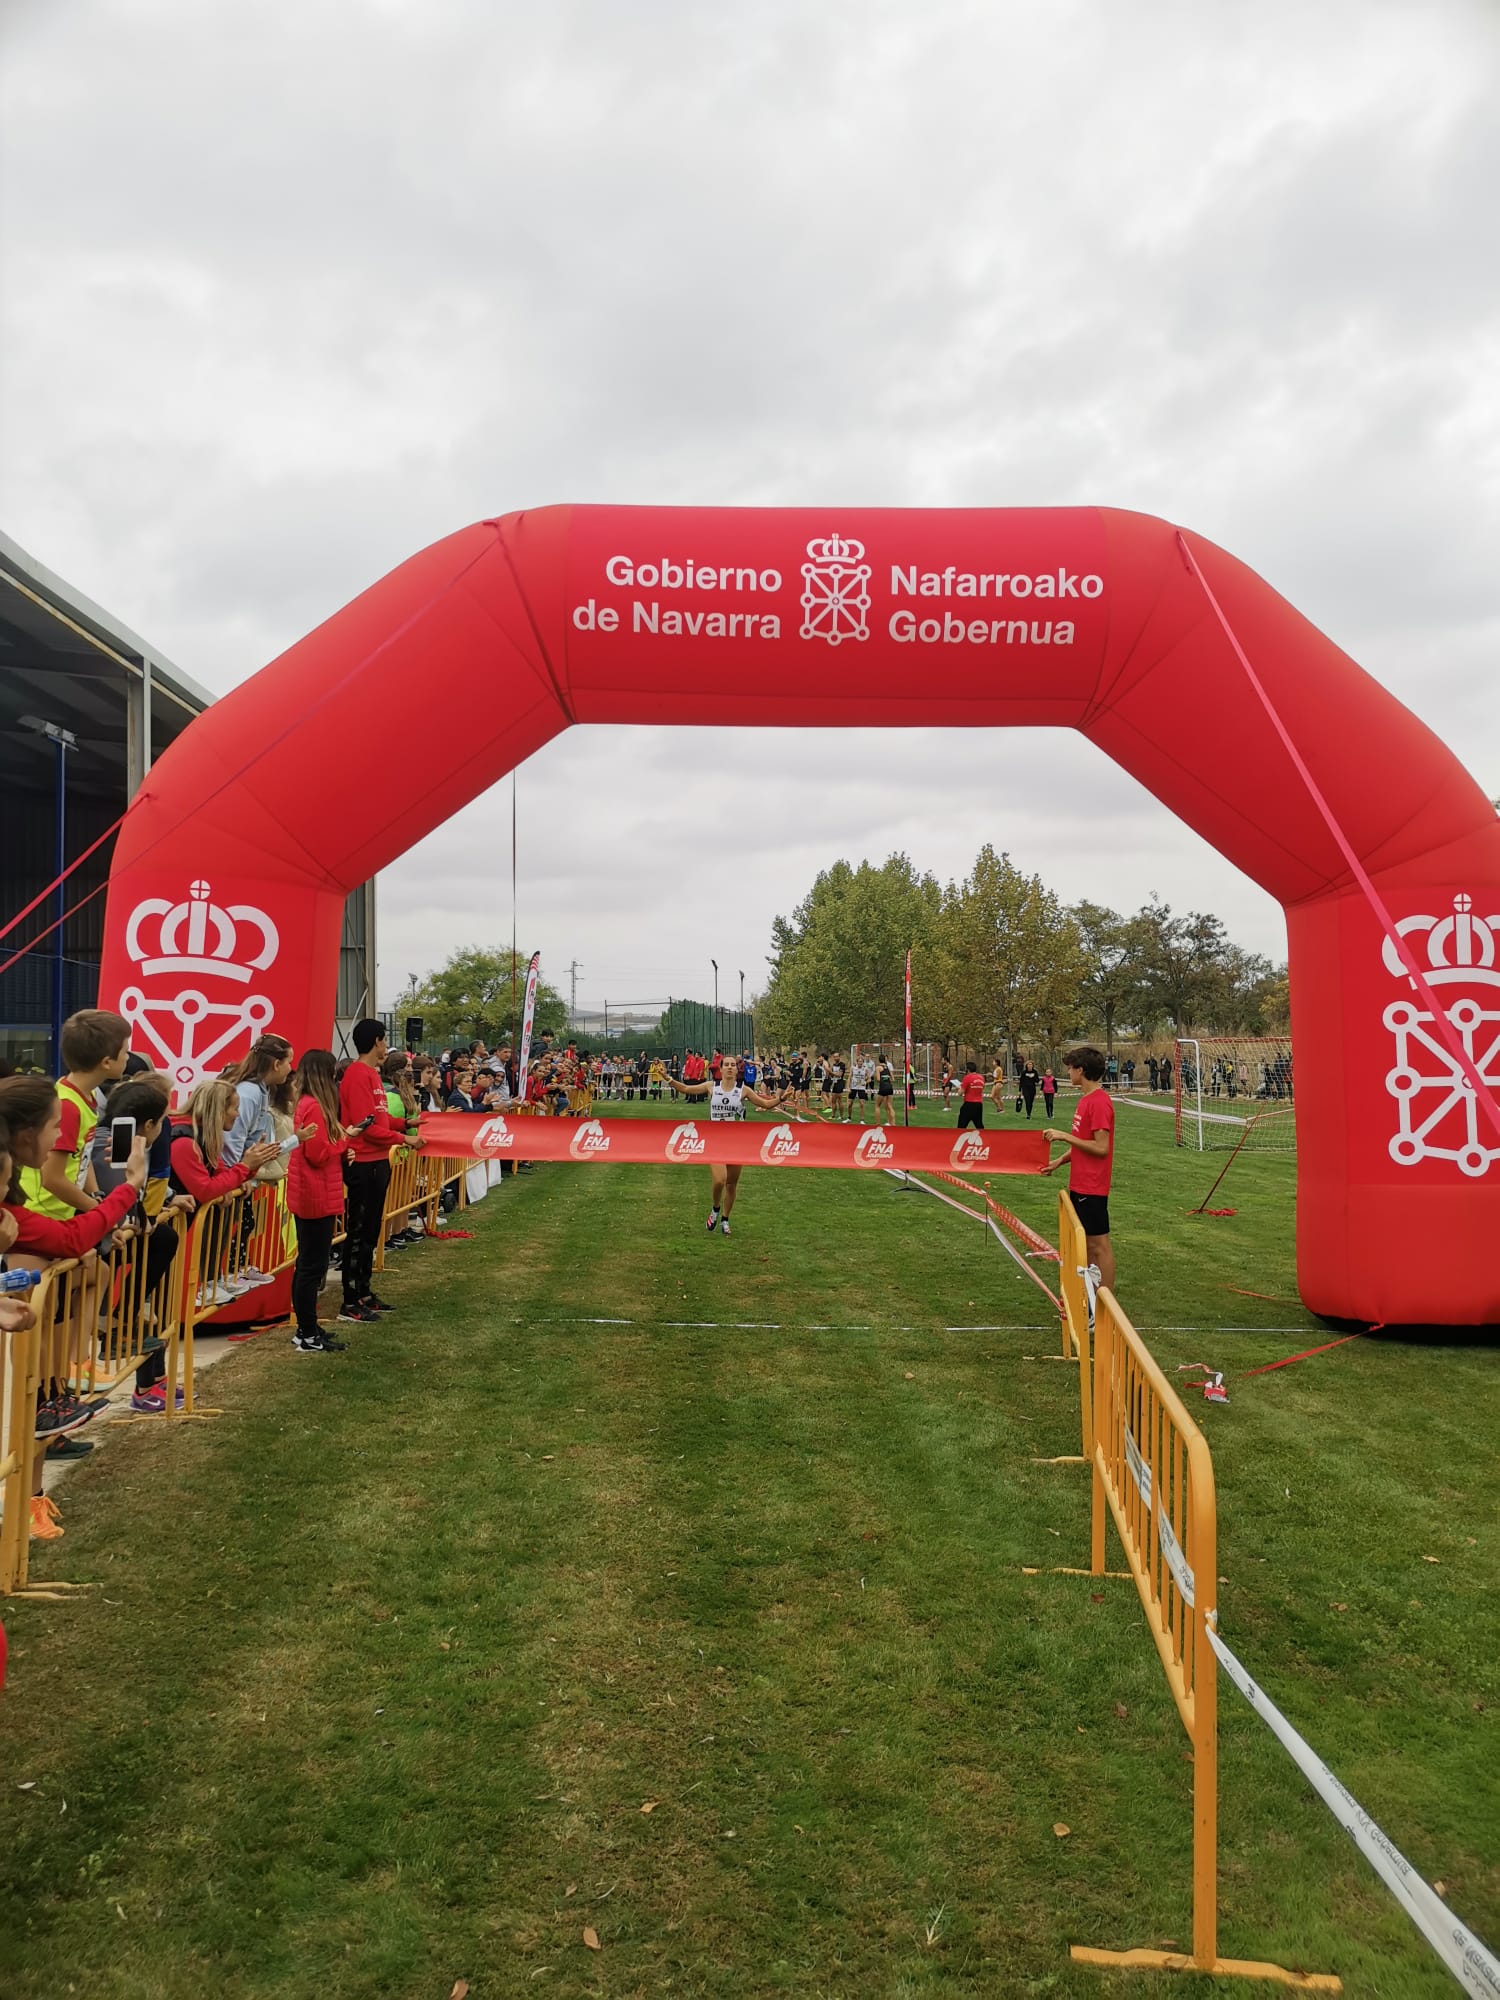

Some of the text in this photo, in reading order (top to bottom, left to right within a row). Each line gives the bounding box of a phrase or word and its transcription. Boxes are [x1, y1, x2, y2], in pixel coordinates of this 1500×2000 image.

[606, 555, 783, 593] Gobierno
[891, 565, 1104, 598] Nafarroako
[573, 598, 781, 639] de Navarra
[888, 609, 1075, 645] Gobernua
[487, 1132, 514, 1146] FNA
[584, 1135, 610, 1148] FNA
[680, 1138, 705, 1150] FNA
[774, 1140, 800, 1152] FNA
[868, 1143, 894, 1155] FNA
[963, 1146, 990, 1158] FNA
